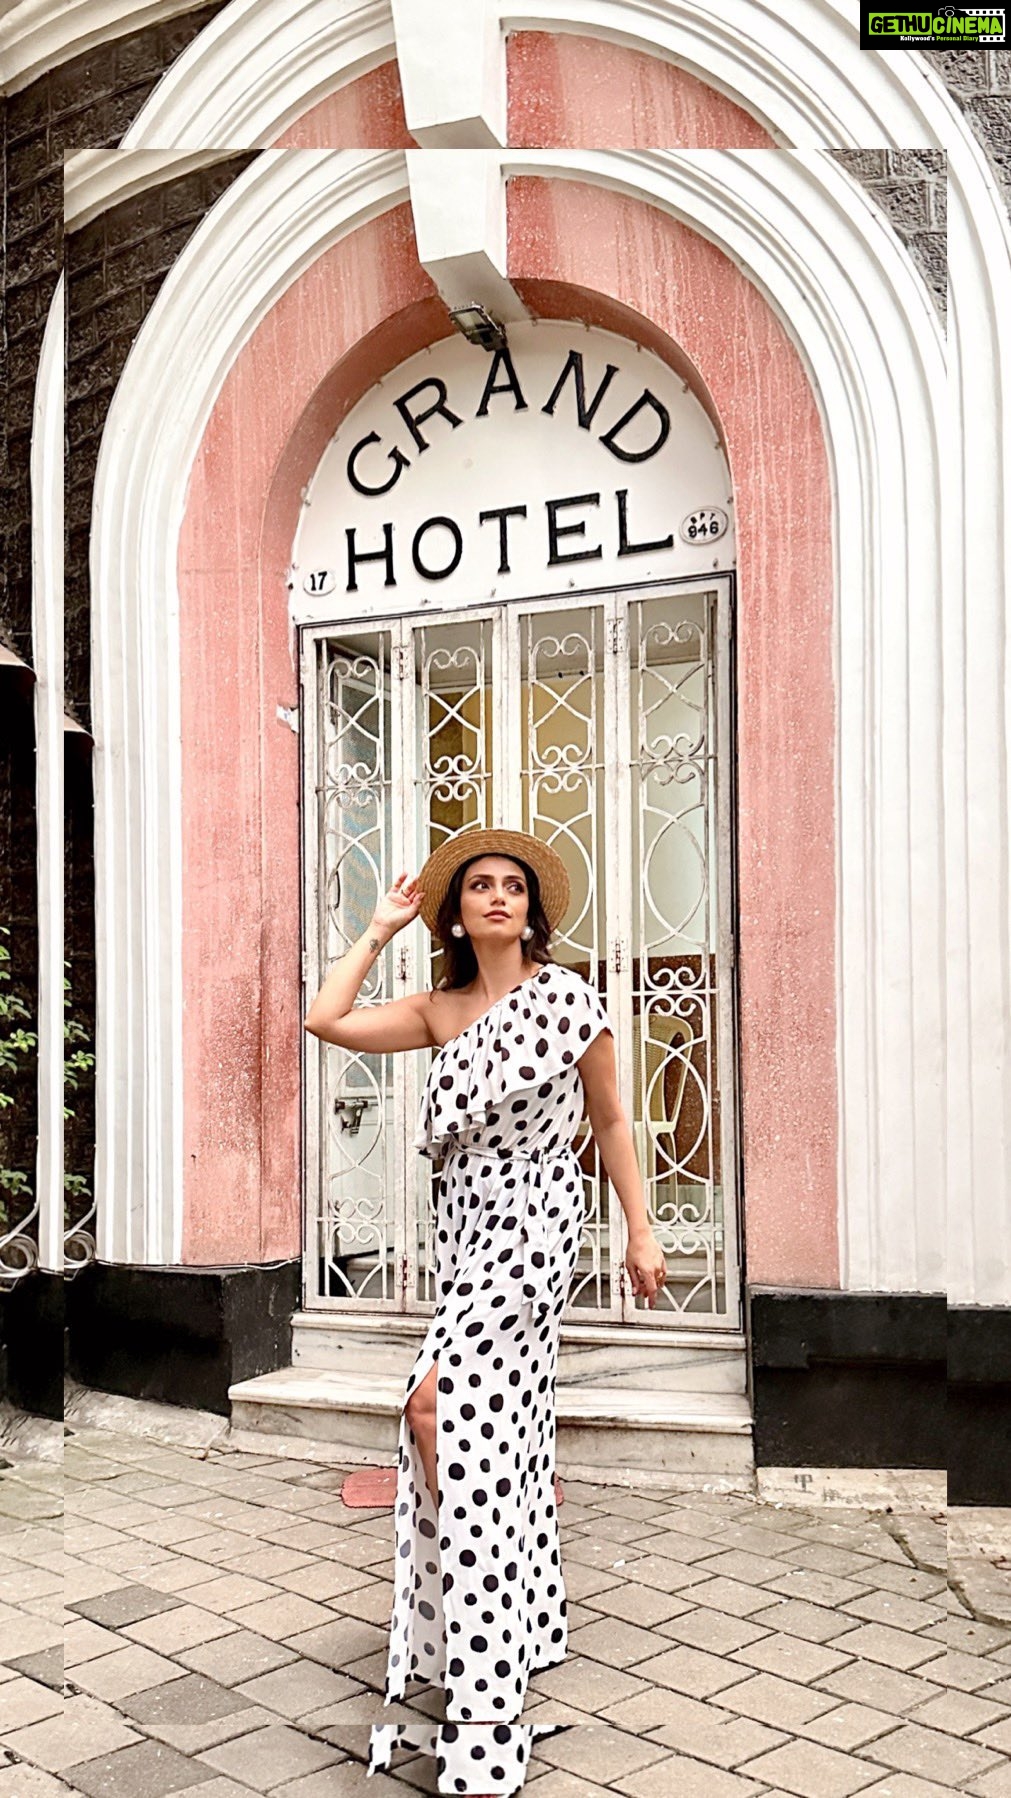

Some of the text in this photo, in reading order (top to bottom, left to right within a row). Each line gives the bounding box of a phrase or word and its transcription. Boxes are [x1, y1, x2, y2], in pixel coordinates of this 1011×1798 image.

[346, 348, 671, 497] GRAND
[310, 571, 328, 591] 17
[345, 489, 675, 592] HOTEL
